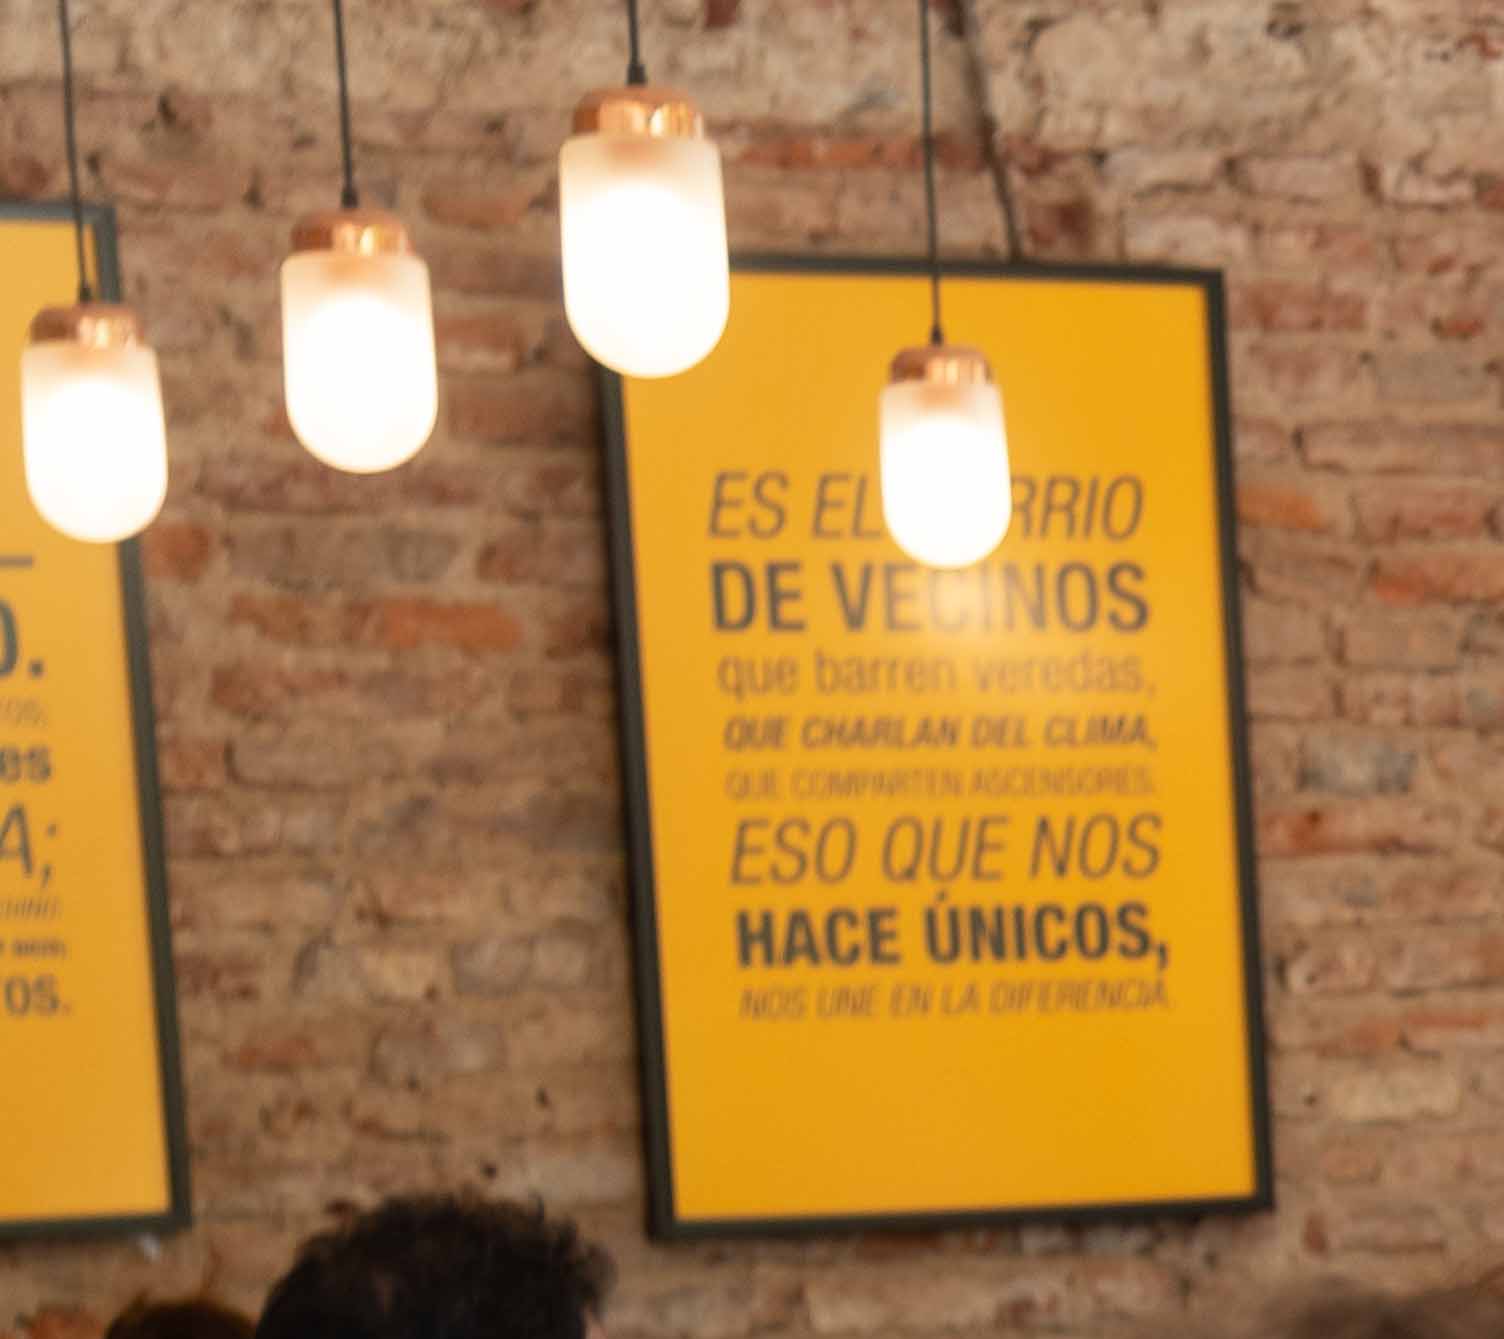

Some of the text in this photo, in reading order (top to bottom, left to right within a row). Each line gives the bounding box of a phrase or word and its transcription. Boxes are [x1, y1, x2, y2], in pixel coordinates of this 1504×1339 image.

[708, 470, 1145, 543] ES EL RRIO
[709, 560, 1149, 633] DE VECINOS
[717, 655, 799, 701] que
[814, 648, 957, 693] barren
[722, 714, 1157, 752] QUE CHARLAN DEL CLIMA,
[723, 769, 778, 800] QUE
[728, 813, 1162, 888] ESO QUE NOS
[735, 888, 1169, 973] HACE ÚNICOS,
[739, 984, 807, 1020] NOS
[888, 983, 930, 1015] EN
[940, 981, 981, 1014] LA
